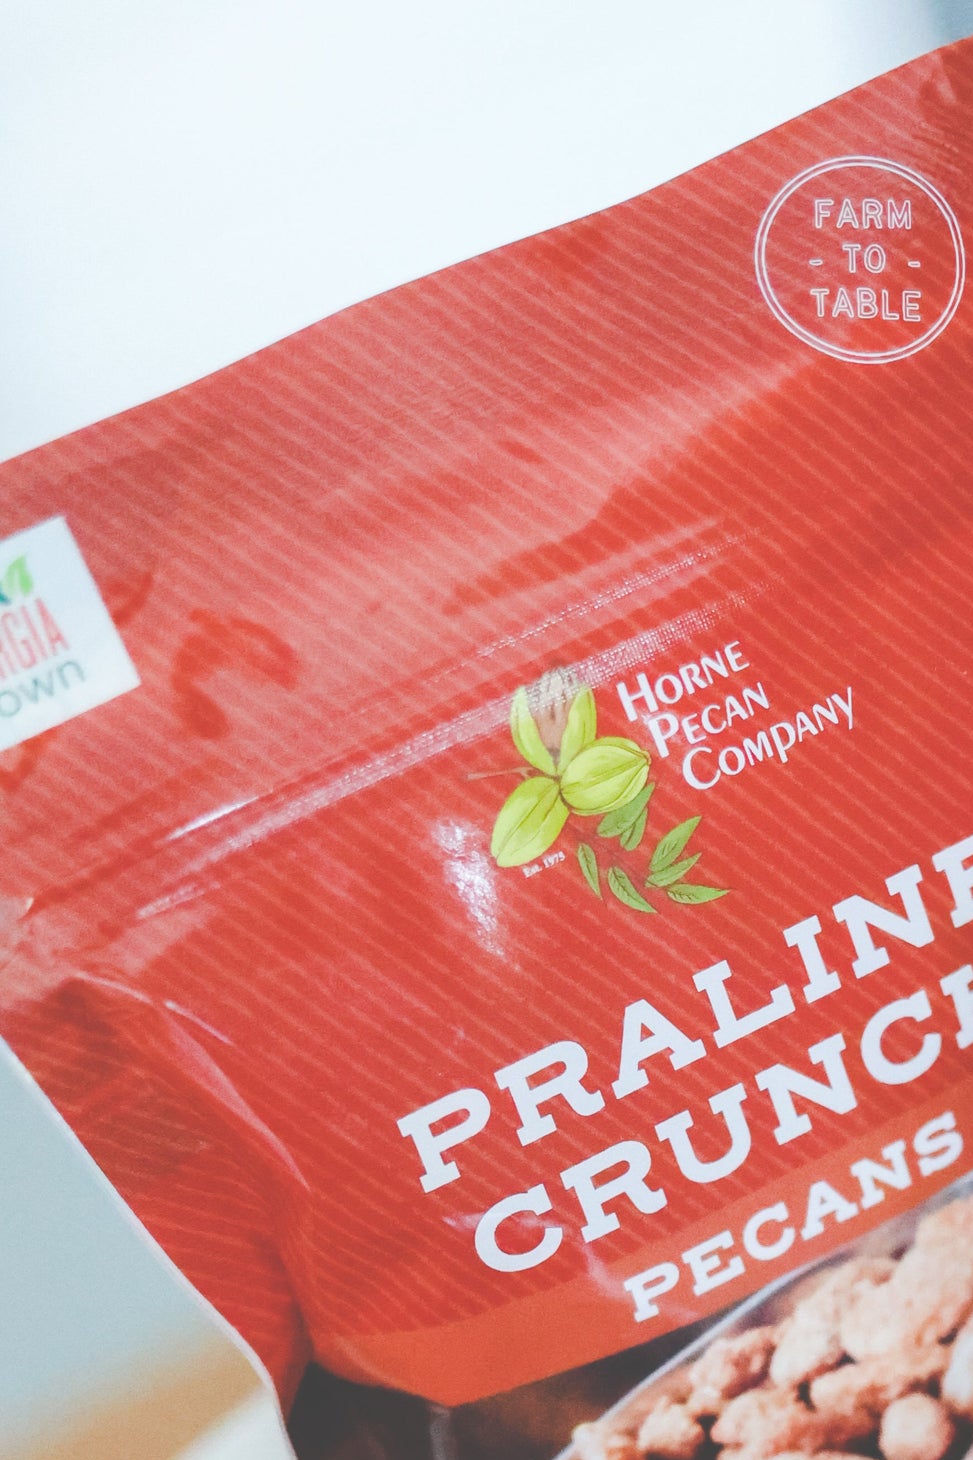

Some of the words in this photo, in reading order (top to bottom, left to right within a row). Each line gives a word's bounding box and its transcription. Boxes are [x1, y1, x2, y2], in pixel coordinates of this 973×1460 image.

[813, 198, 913, 230] FARM
[841, 243, 887, 274] TO
[809, 287, 922, 322] TABLE
[615, 640, 751, 723] HORNE
[645, 681, 771, 759] PECAN
[681, 685, 853, 791] COMPANY
[622, 1110, 965, 1323] PECANS
